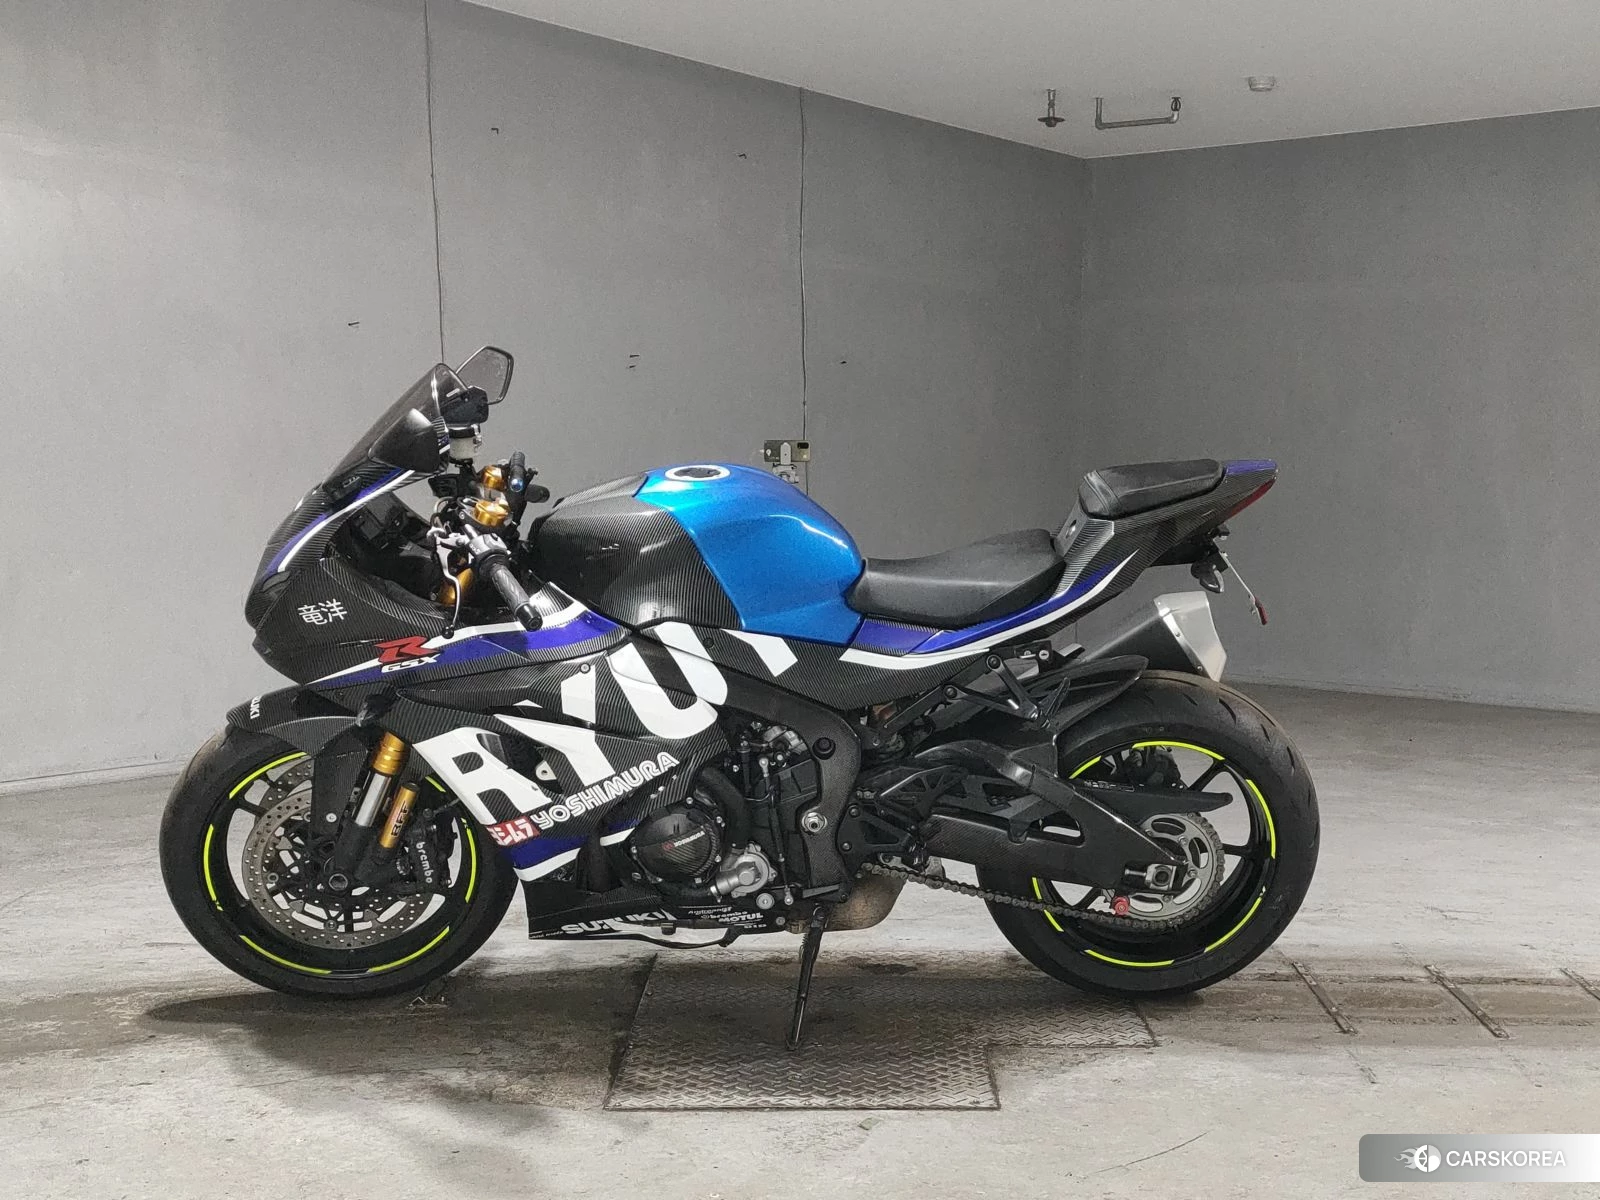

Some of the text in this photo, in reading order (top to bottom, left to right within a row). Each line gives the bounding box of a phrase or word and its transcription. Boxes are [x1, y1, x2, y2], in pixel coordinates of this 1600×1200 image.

[297, 598, 348, 625] 竜洋
[381, 653, 441, 674] GSX
[530, 751, 681, 830] YOSHIMURA
[416, 841, 435, 884] brembo
[718, 911, 764, 923] MOTUL
